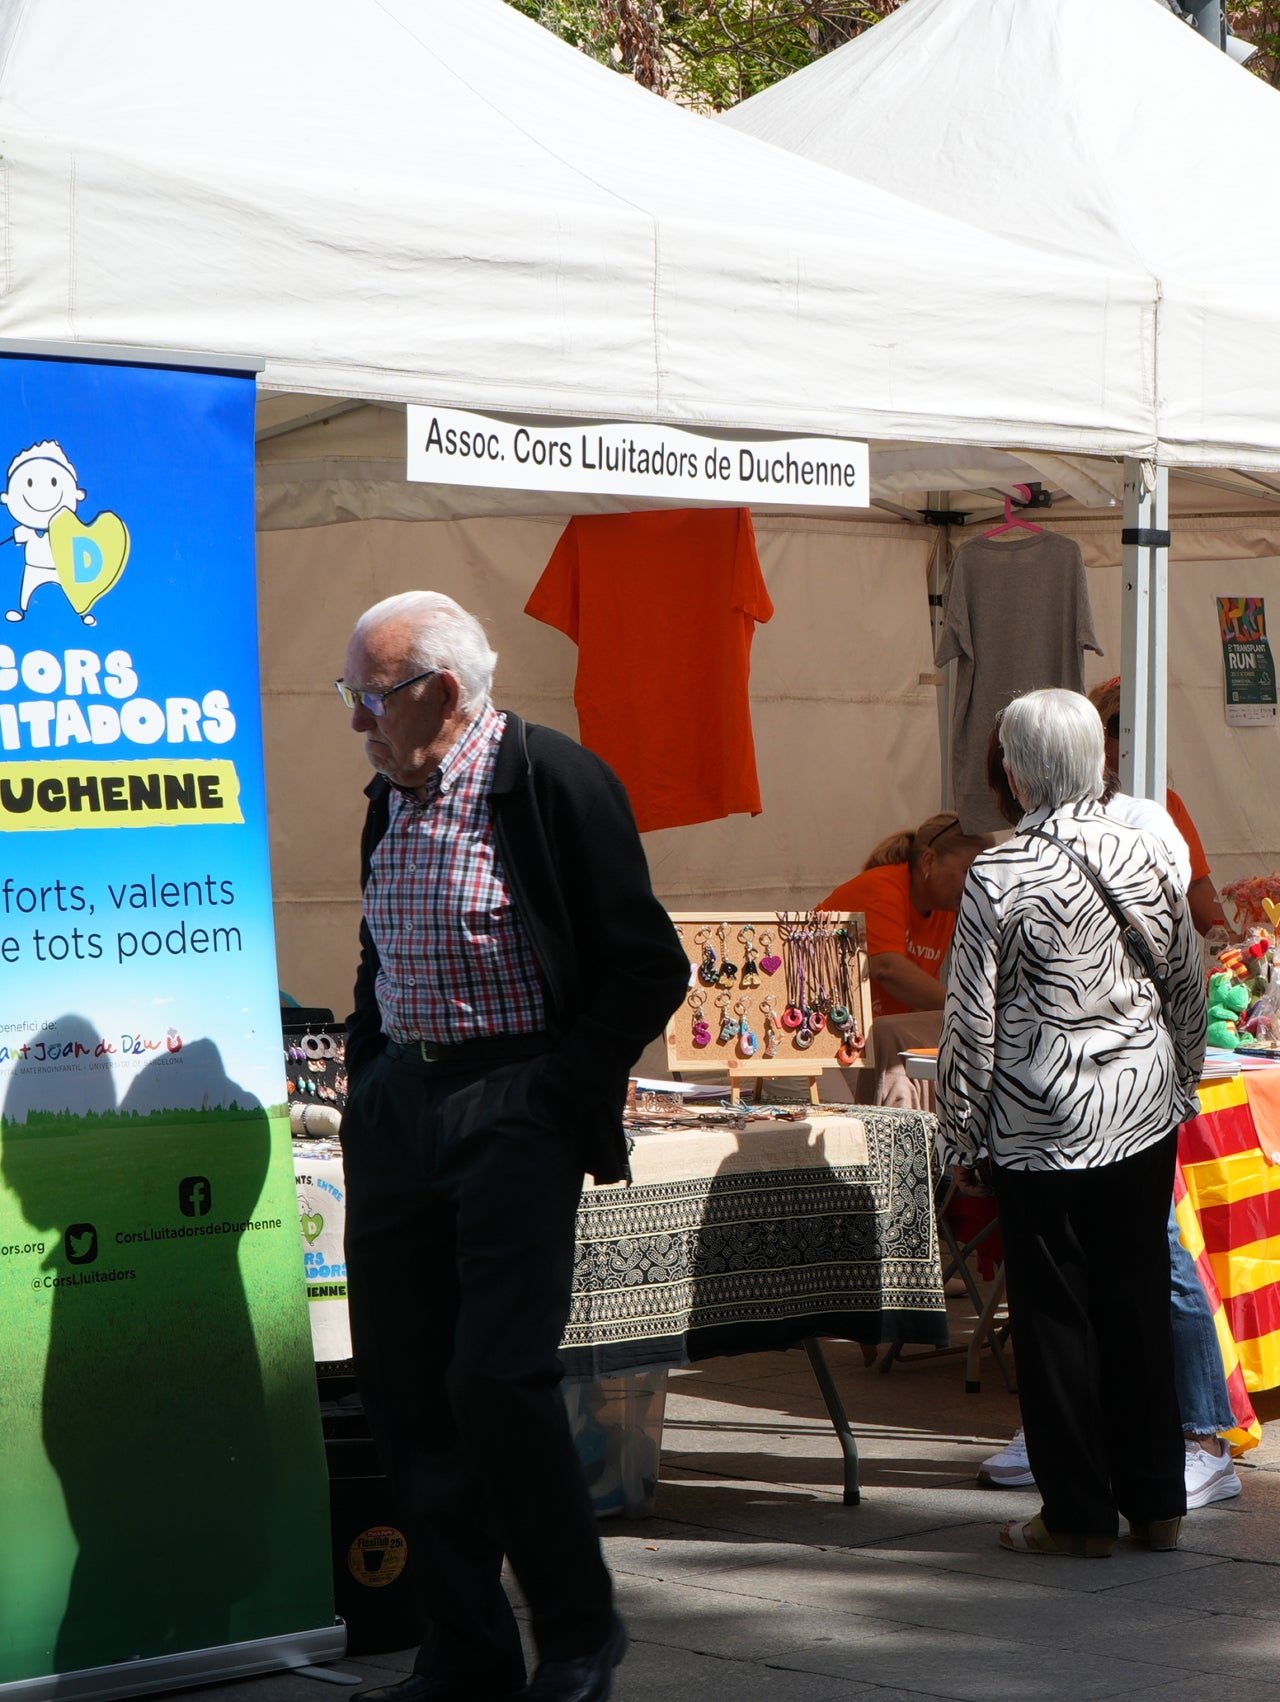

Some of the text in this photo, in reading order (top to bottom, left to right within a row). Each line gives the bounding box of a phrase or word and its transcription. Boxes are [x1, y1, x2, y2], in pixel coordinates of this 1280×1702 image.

[425, 417, 856, 488] Assoc. Cors Lluitadors de Duchenne
[1229, 653, 1256, 669] RUN
[2, 874, 235, 915] forts, valents
[33, 927, 103, 961] tots
[117, 920, 243, 965] podem
[42, 1021, 57, 1032] de:
[35, 1041, 90, 1061] Joan
[94, 1038, 117, 1058] de
[316, 1178, 344, 1202] ENTRE
[115, 1216, 282, 1246] CorsLluitadorsdeDuchenne
[31, 1268, 137, 1290] @CorsLluitadors
